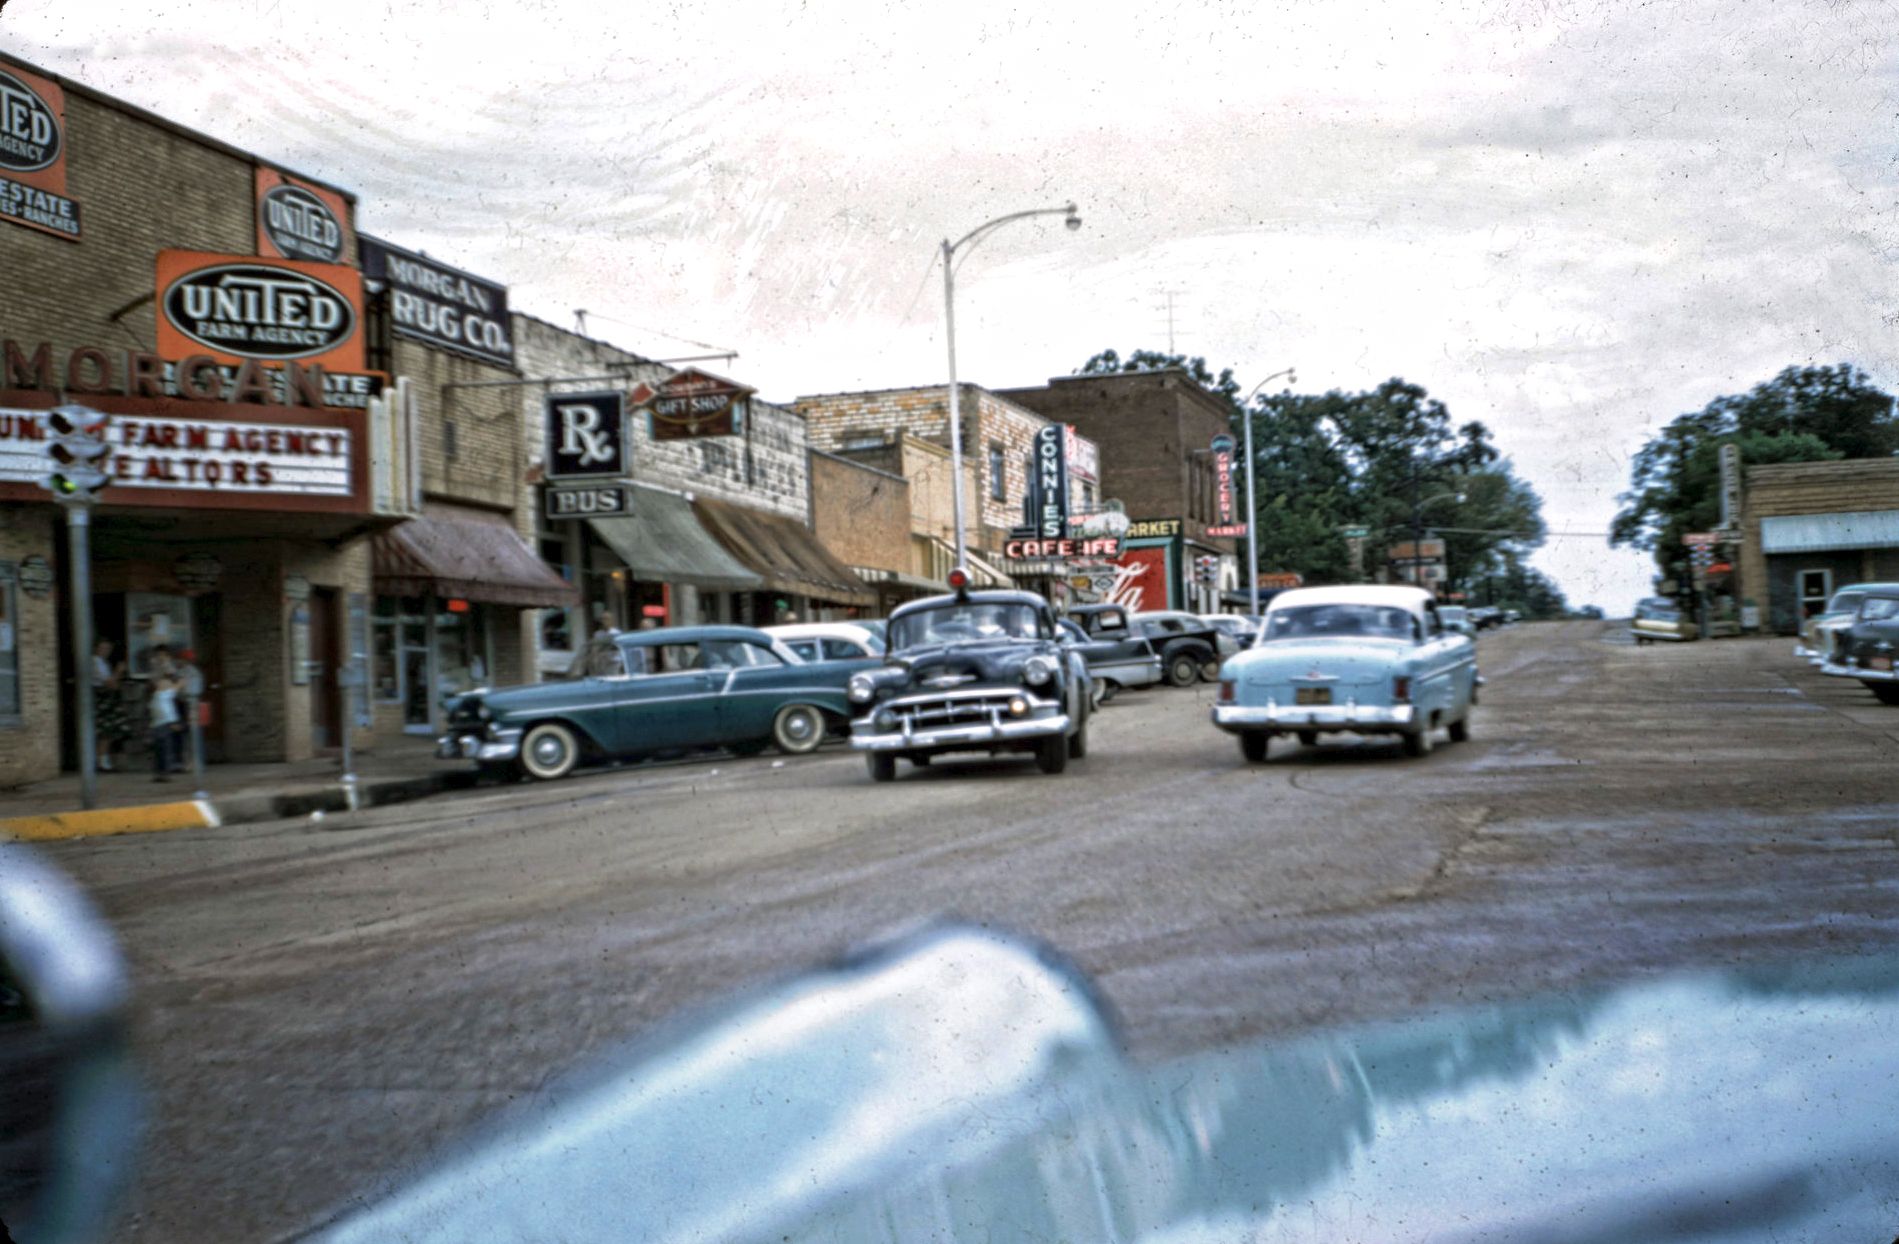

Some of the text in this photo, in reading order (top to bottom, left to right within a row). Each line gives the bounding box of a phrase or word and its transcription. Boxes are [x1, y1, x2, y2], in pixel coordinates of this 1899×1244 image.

[268, 194, 338, 248] UNITED
[385, 253, 491, 313] MORGAN
[182, 274, 341, 330] UNITED
[389, 287, 460, 340] RUG
[196, 321, 328, 346] FARM AGENCY
[4, 339, 325, 408] MORGAN
[655, 395, 728, 416] GIFT SHOP
[123, 421, 207, 449] FARM
[223, 427, 342, 458] AGENCY
[115, 455, 273, 486] EALTORS
[1040, 426, 1064, 538] CONNIE'S
[556, 489, 620, 513] BUS
[1127, 520, 1182, 538] ARKET
[1006, 538, 1074, 559] CAFE
